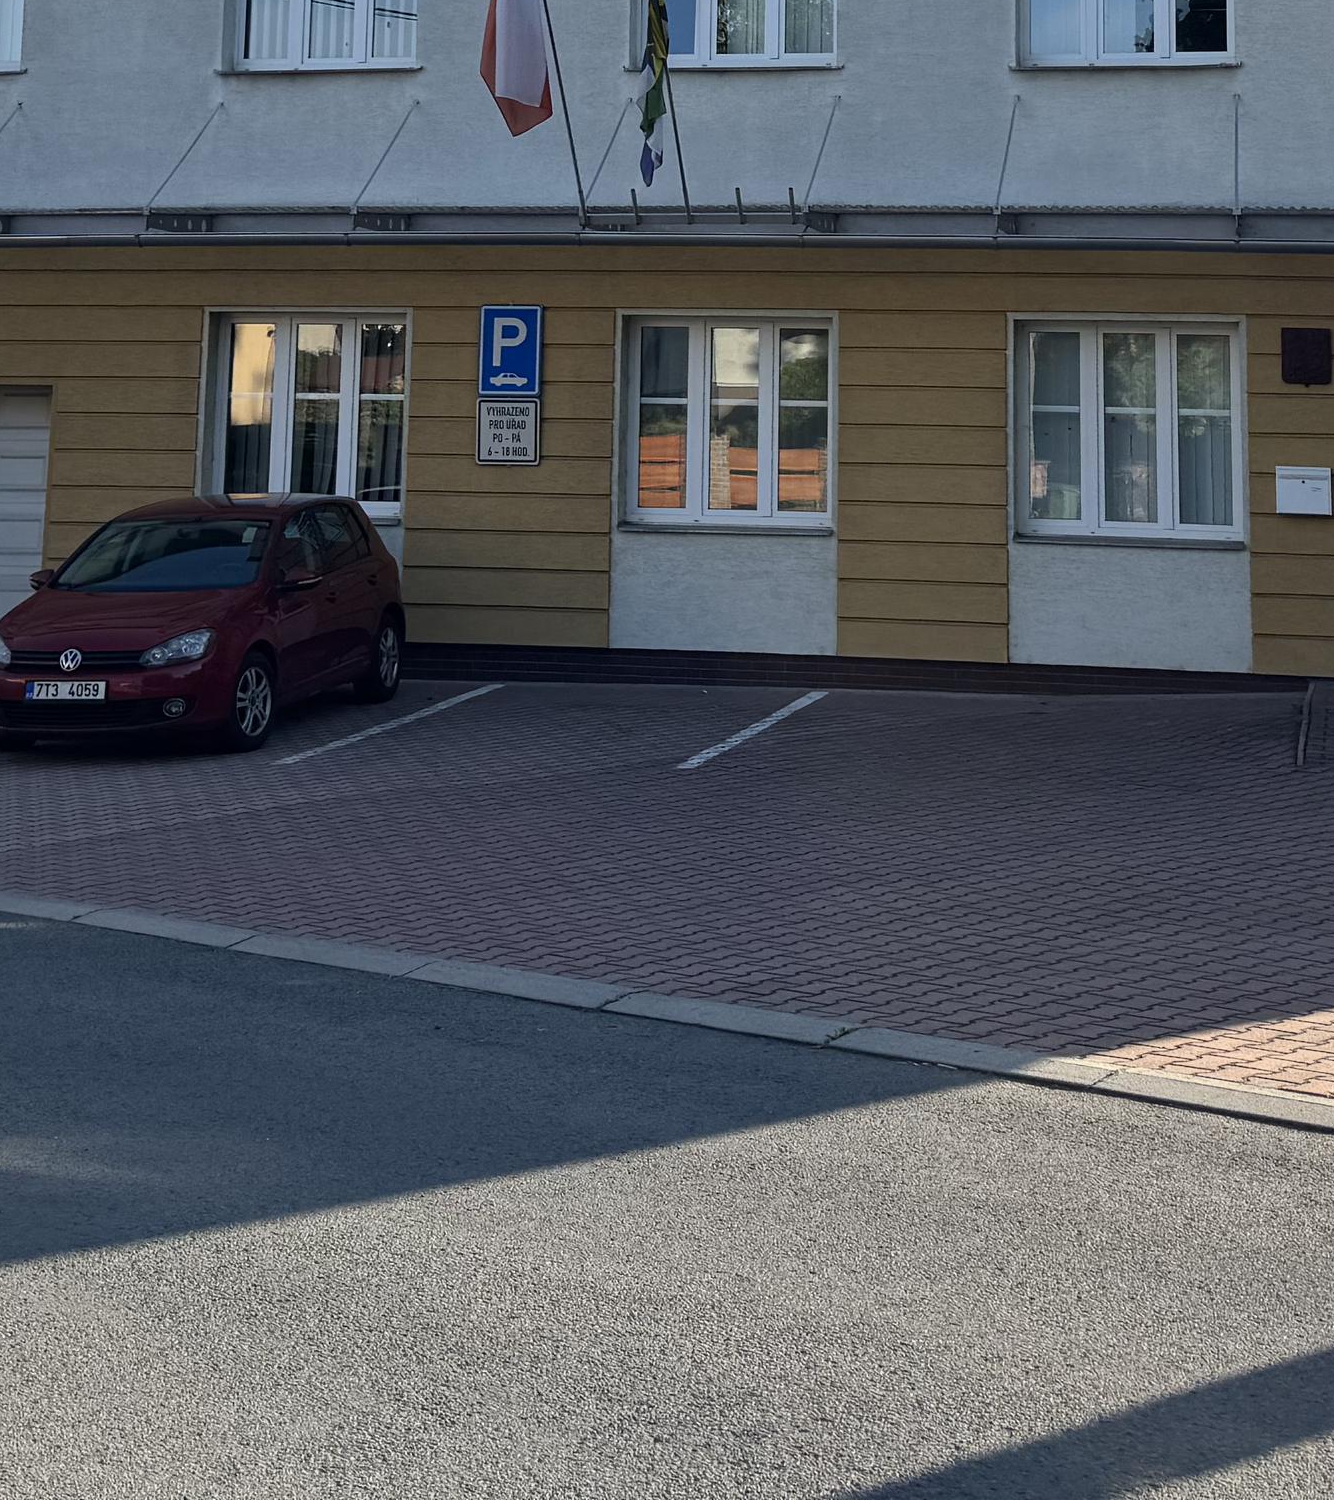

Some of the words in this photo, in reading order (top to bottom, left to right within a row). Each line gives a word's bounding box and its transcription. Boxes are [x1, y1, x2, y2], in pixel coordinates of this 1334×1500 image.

[492, 317, 528, 367] P
[487, 406, 530, 417] VYHRAZENO
[489, 419, 504, 430] PRO
[493, 433, 503, 443] PO
[512, 430, 522, 443] PÁ
[487, 446, 493, 457] 6
[501, 446, 511, 457] 18
[512, 446, 530, 457] HOD.
[36, 683, 59, 697] 7T3
[68, 683, 100, 697] 4059
